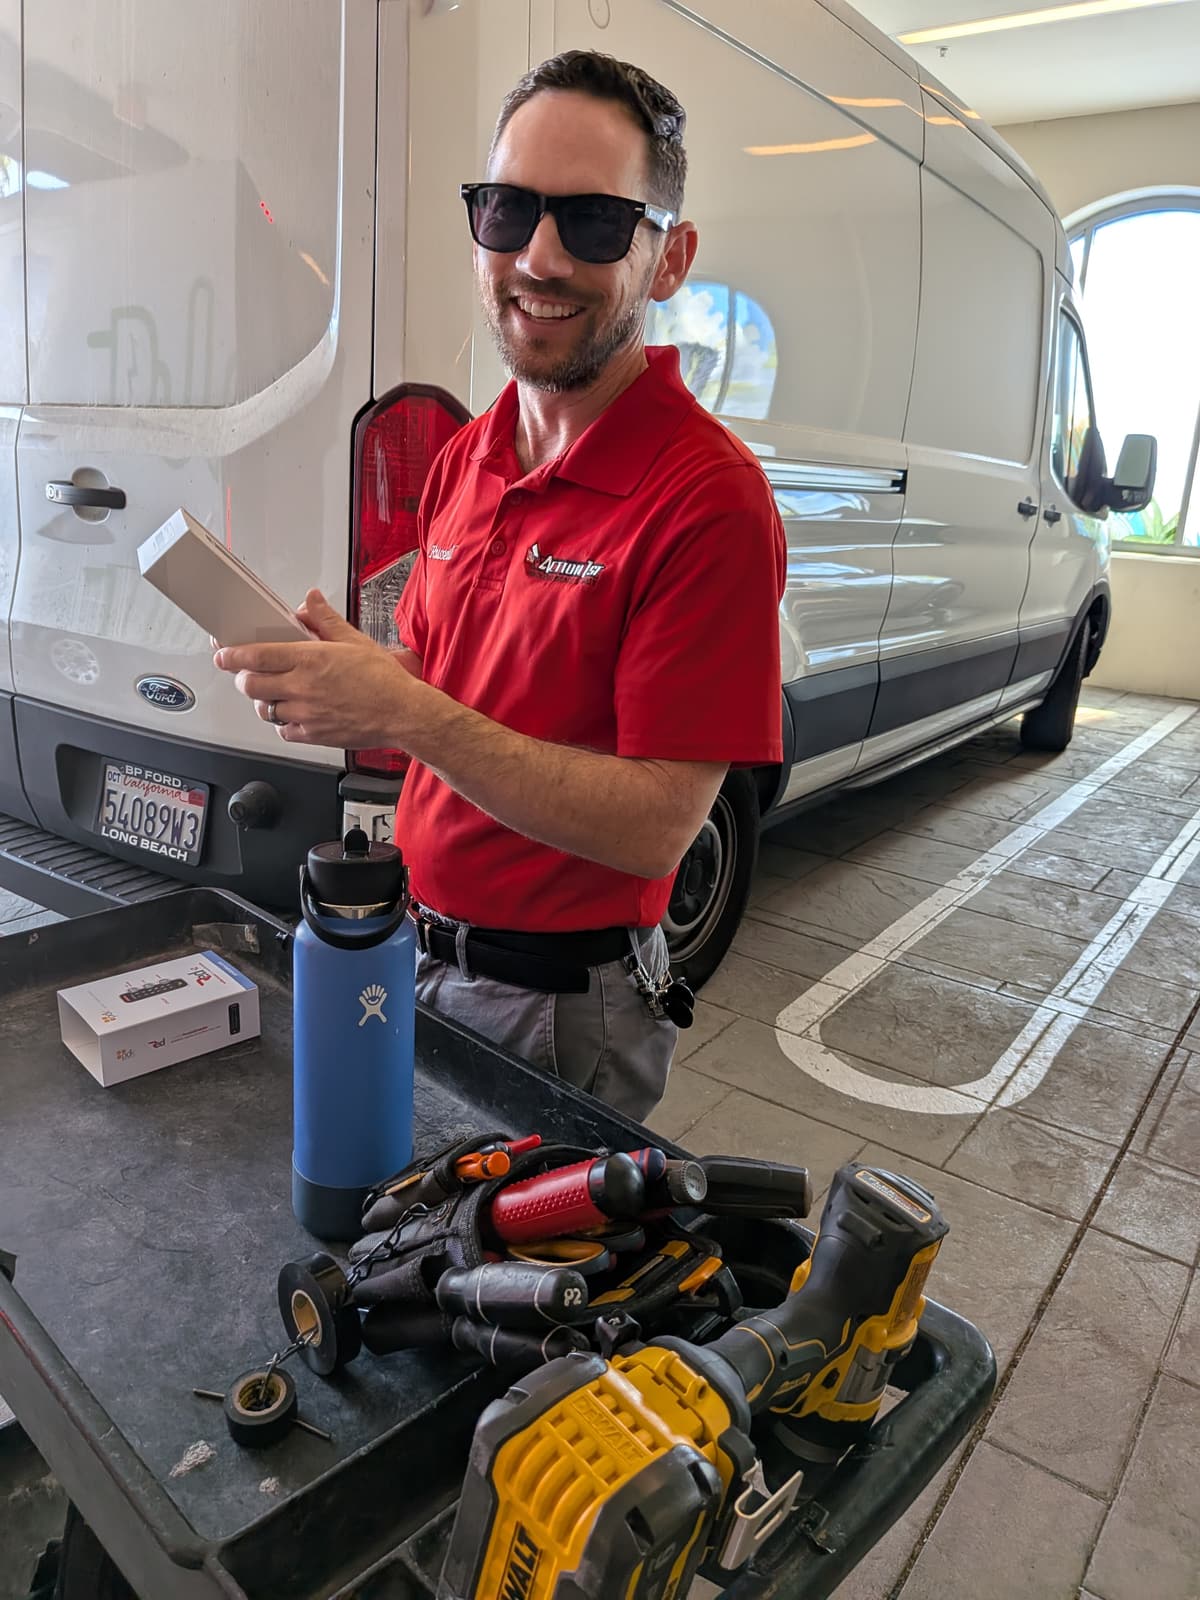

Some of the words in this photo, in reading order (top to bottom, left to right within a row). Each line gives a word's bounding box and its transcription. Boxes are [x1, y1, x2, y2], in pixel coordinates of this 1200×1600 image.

[146, 683, 177, 704] Ford
[107, 770, 121, 784] OCT
[125, 765, 143, 777] BP
[144, 770, 182, 788] FORD
[104, 788, 200, 849] 54089W3
[101, 826, 138, 846] LONG
[140, 838, 188, 861] BEACH
[564, 1287, 582, 1307] P2
[571, 1395, 645, 1462] DEWALT
